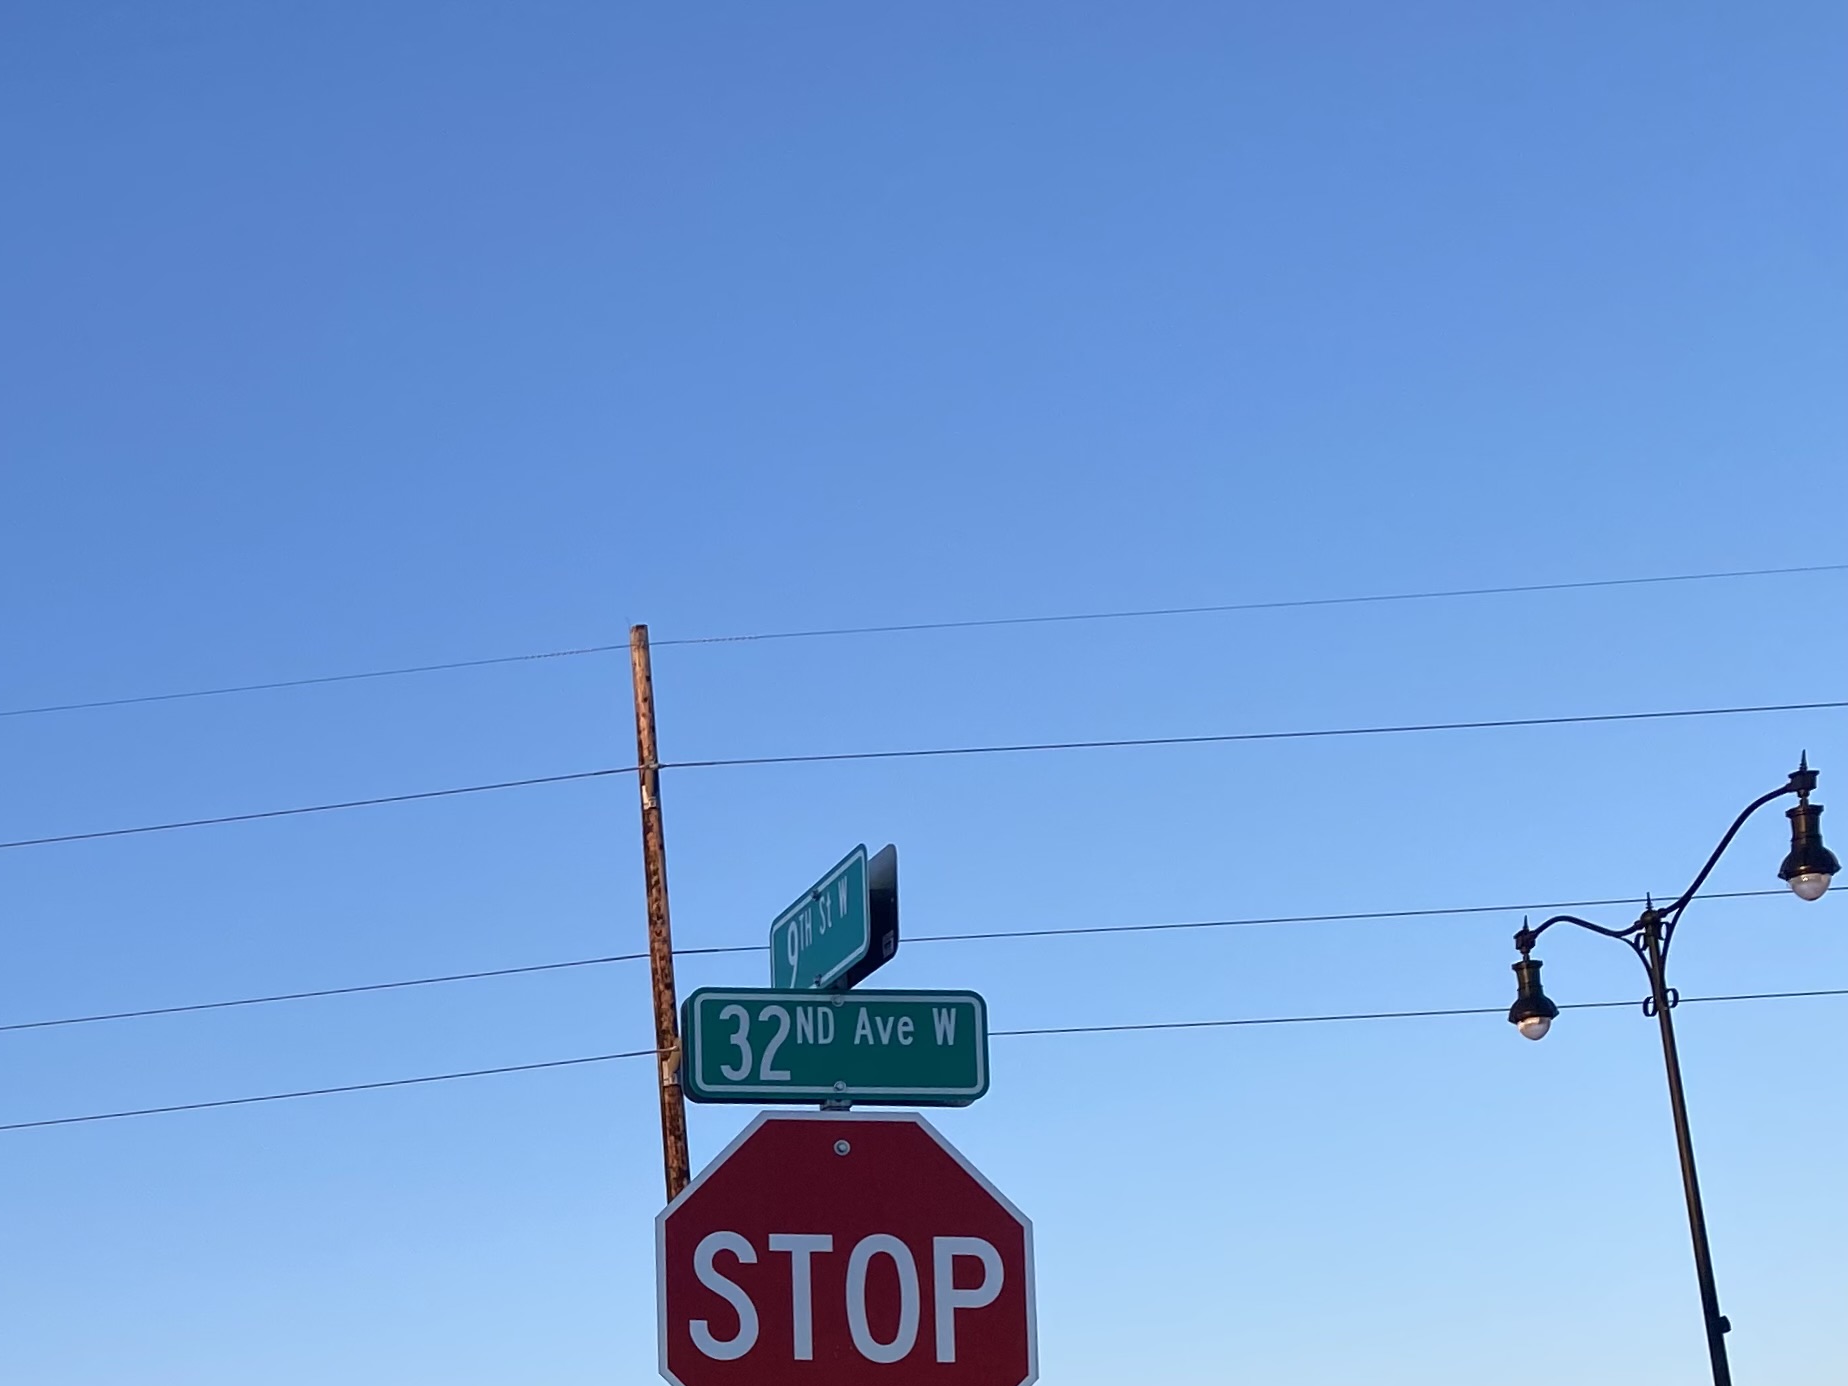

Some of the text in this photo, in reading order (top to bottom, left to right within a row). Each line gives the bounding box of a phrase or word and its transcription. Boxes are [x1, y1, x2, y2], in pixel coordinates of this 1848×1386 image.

[788, 876, 848, 988] 9TH St W
[719, 1004, 956, 1081] 32ND Ave W
[689, 1230, 1005, 1364] STOP
